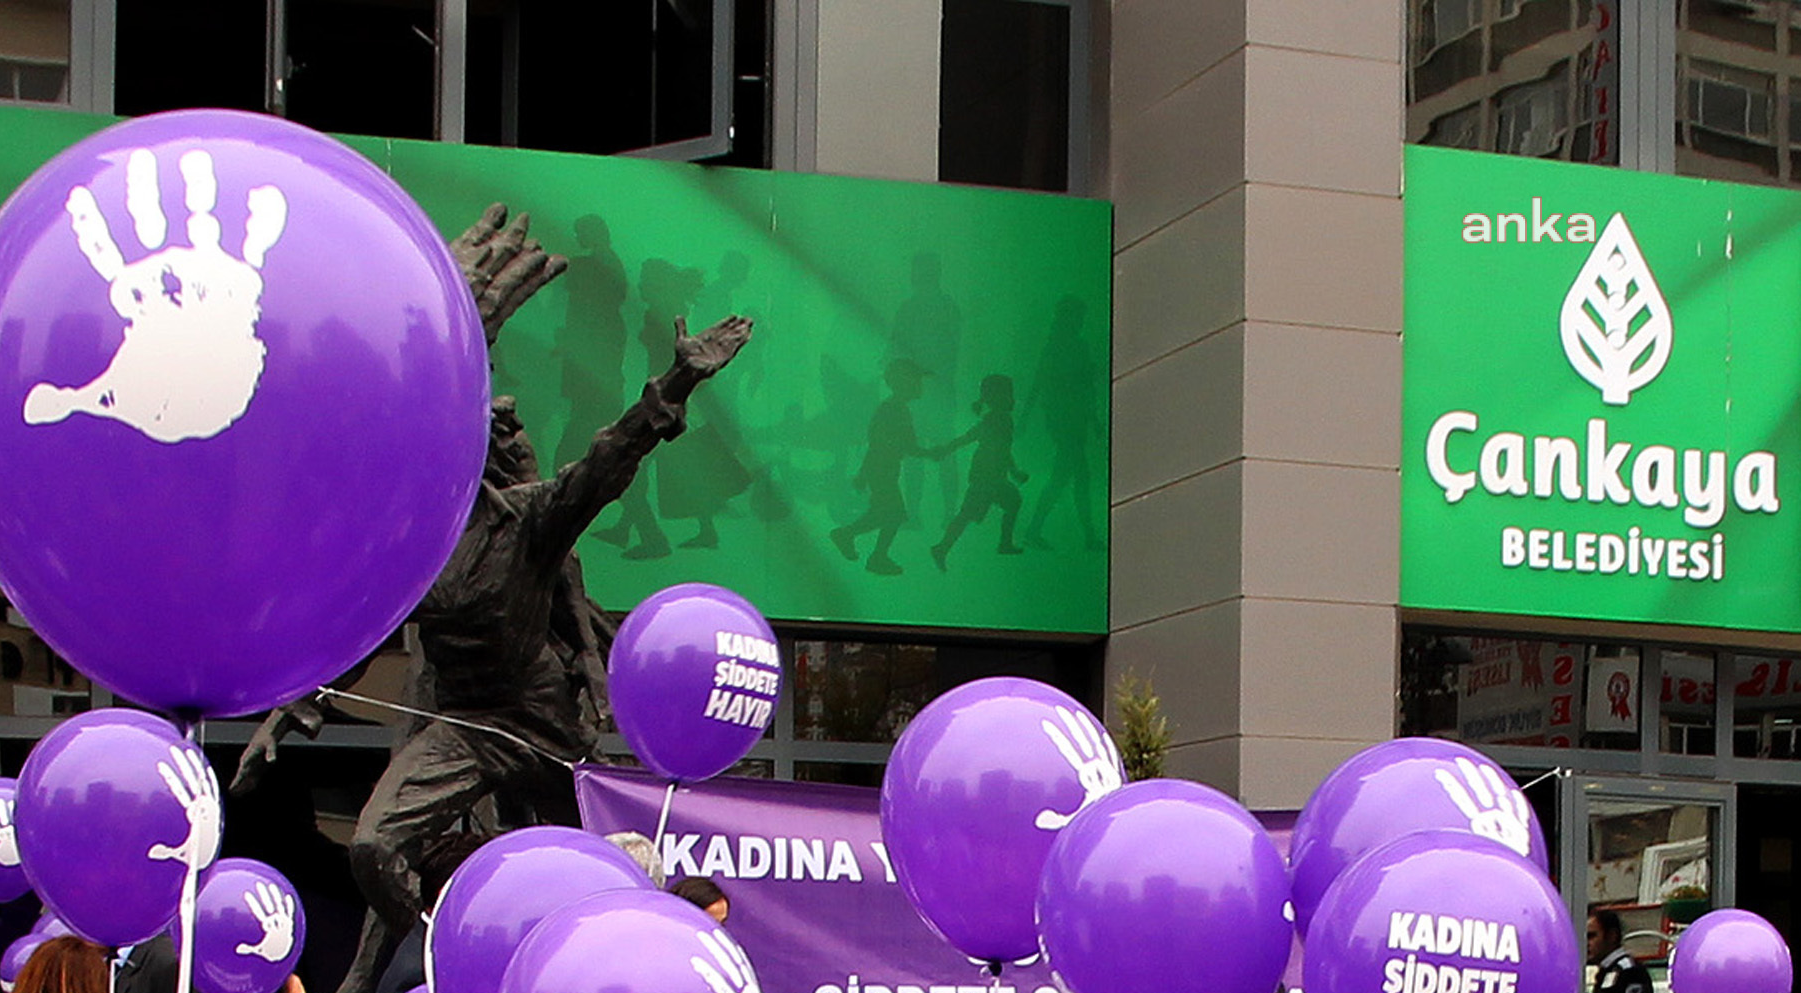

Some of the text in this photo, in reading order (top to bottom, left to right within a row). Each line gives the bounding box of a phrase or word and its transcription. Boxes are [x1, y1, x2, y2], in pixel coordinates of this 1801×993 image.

[1424, 409, 1781, 527] Çankaya
[1500, 526, 1725, 582] BELEDİYESİ
[703, 688, 773, 729] HAYIR
[662, 833, 863, 882] KADINA
[1388, 912, 1520, 963] KADINA
